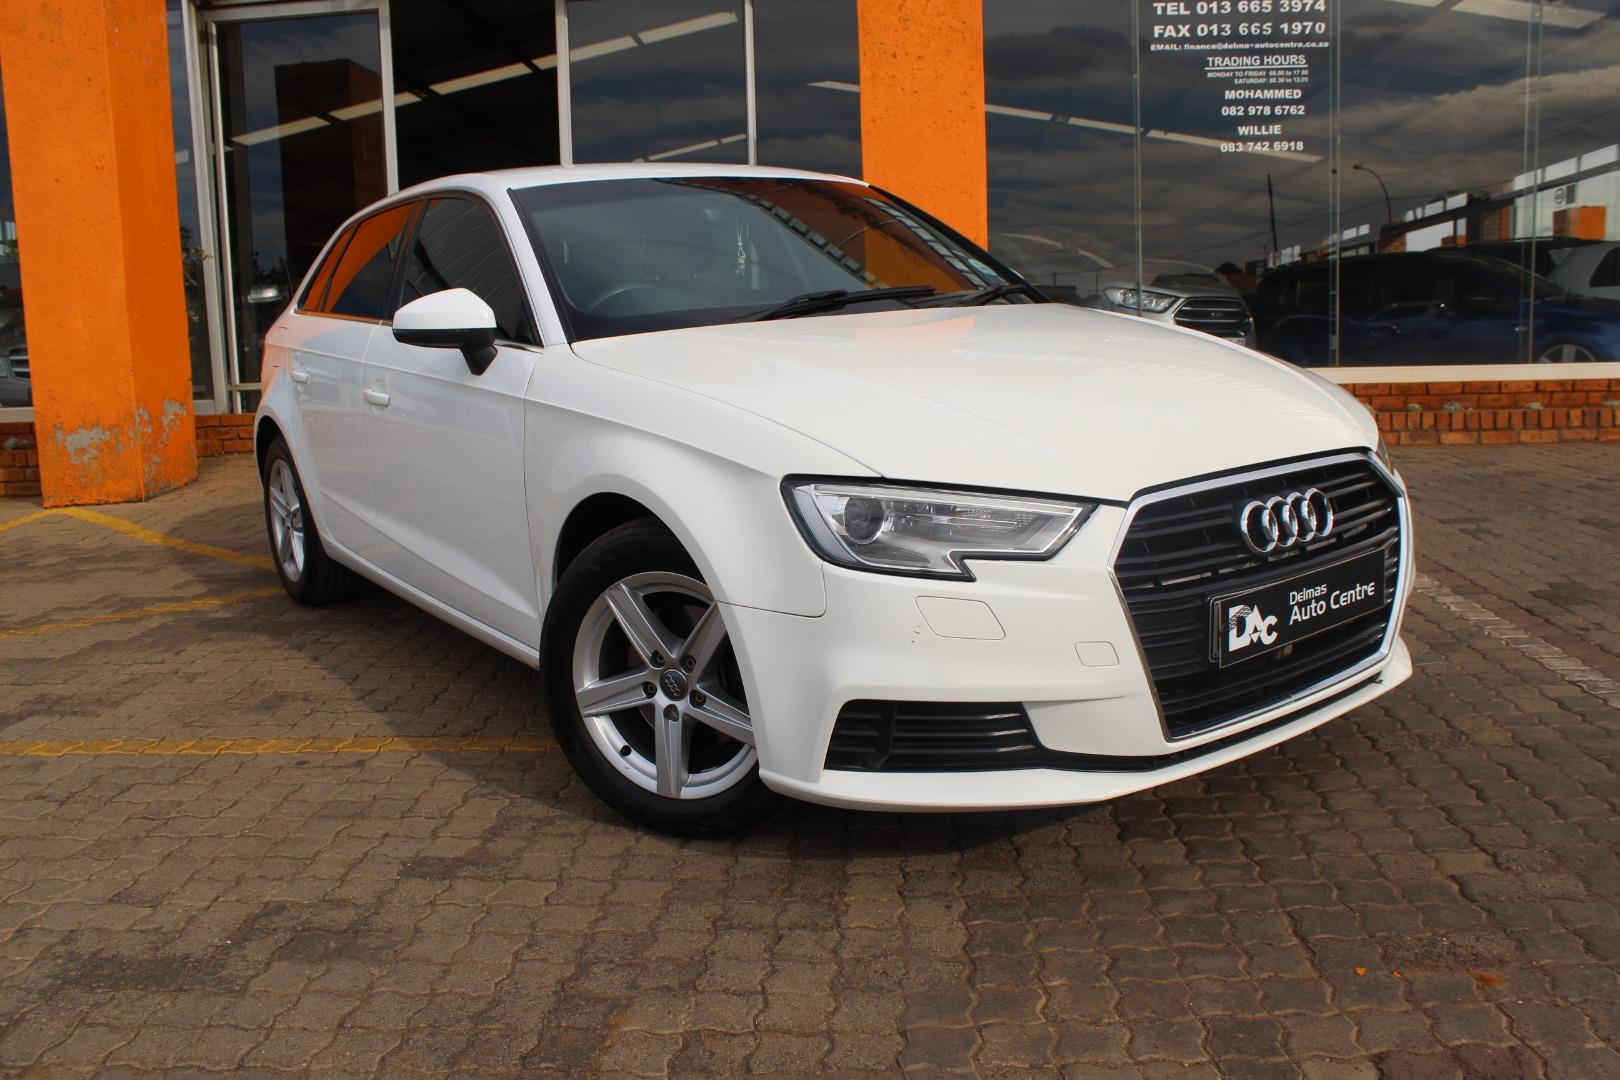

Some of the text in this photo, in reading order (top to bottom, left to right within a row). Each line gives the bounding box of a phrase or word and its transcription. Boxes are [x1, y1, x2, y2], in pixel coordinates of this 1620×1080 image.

[1153, 0, 1326, 15] TEL 013 665 3974
[1153, 22, 1326, 38] FAX 013 665 1970
[1207, 55, 1306, 67] TRADING HOURS
[1224, 89, 1302, 100] MOHAMMED
[1221, 105, 1305, 116] 082 978 6762
[1237, 125, 1282, 136] WILLIE
[1220, 141, 1304, 153] 083 742 6918
[1289, 583, 1328, 606] Delmas
[1289, 581, 1375, 625] Auto Centre
